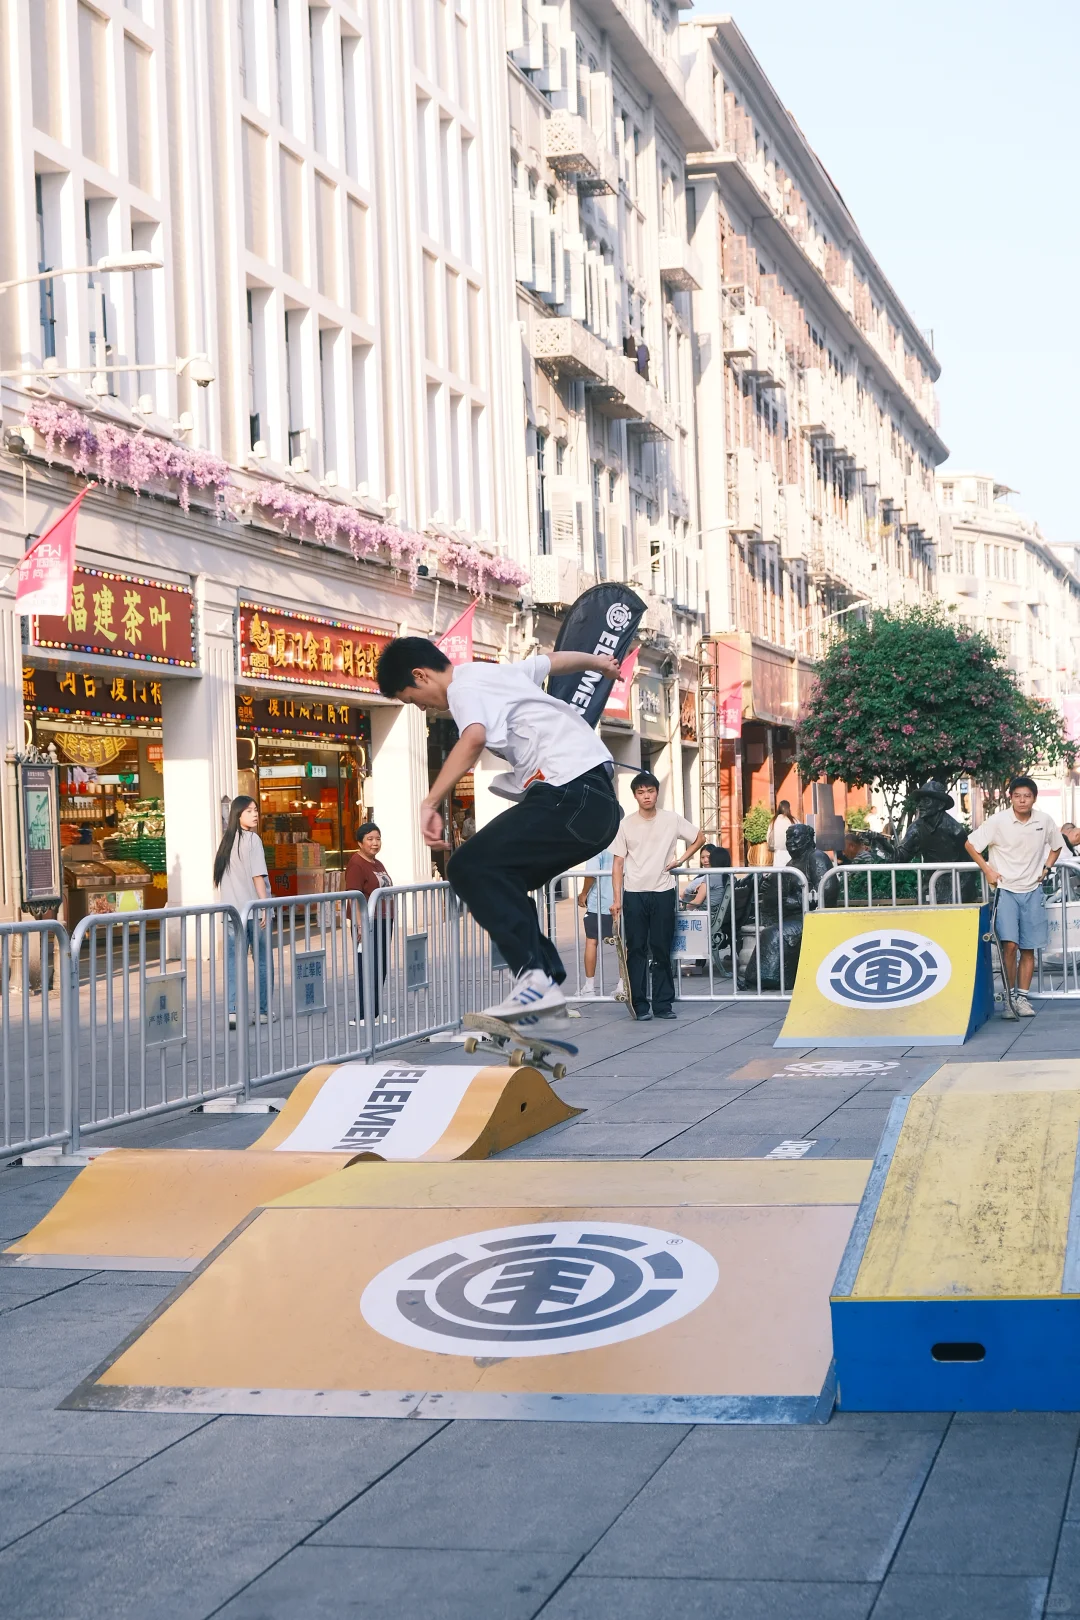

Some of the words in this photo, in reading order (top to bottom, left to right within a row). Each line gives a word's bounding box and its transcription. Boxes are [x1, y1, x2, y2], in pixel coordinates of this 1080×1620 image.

[62, 583, 171, 651] 福建茶叶
[332, 1069, 427, 1151] ELEMEN
